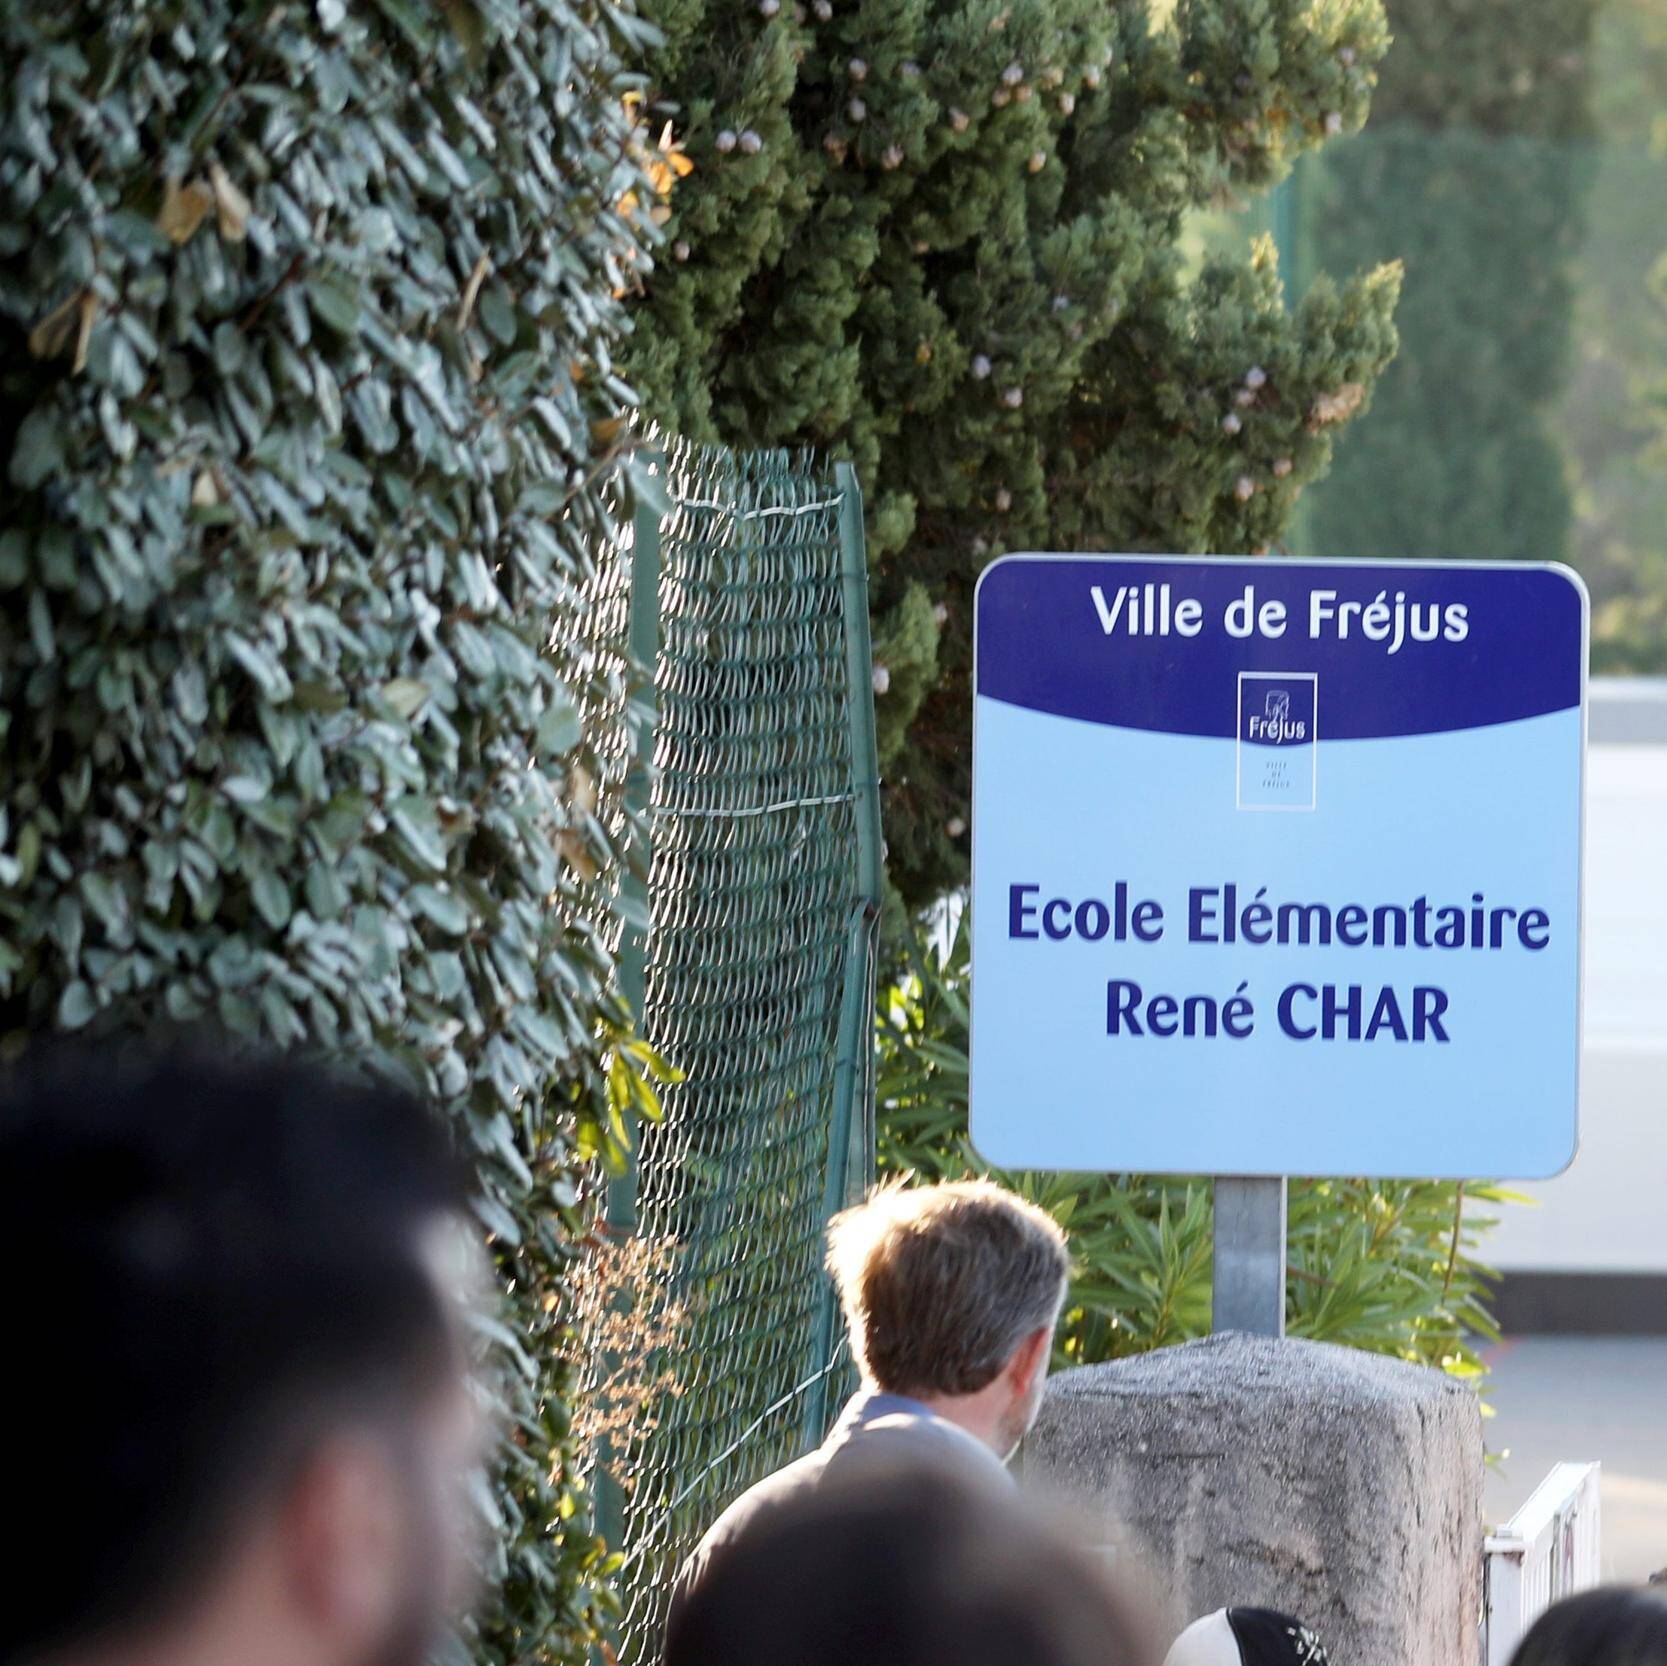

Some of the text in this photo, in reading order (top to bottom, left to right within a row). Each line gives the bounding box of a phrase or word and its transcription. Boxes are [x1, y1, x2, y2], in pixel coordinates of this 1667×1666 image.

[1090, 583, 1470, 655] Ville de Fréjus
[1008, 880, 1551, 951] Ecole Elémentaire
[1105, 979, 1451, 1044] René CHAR
